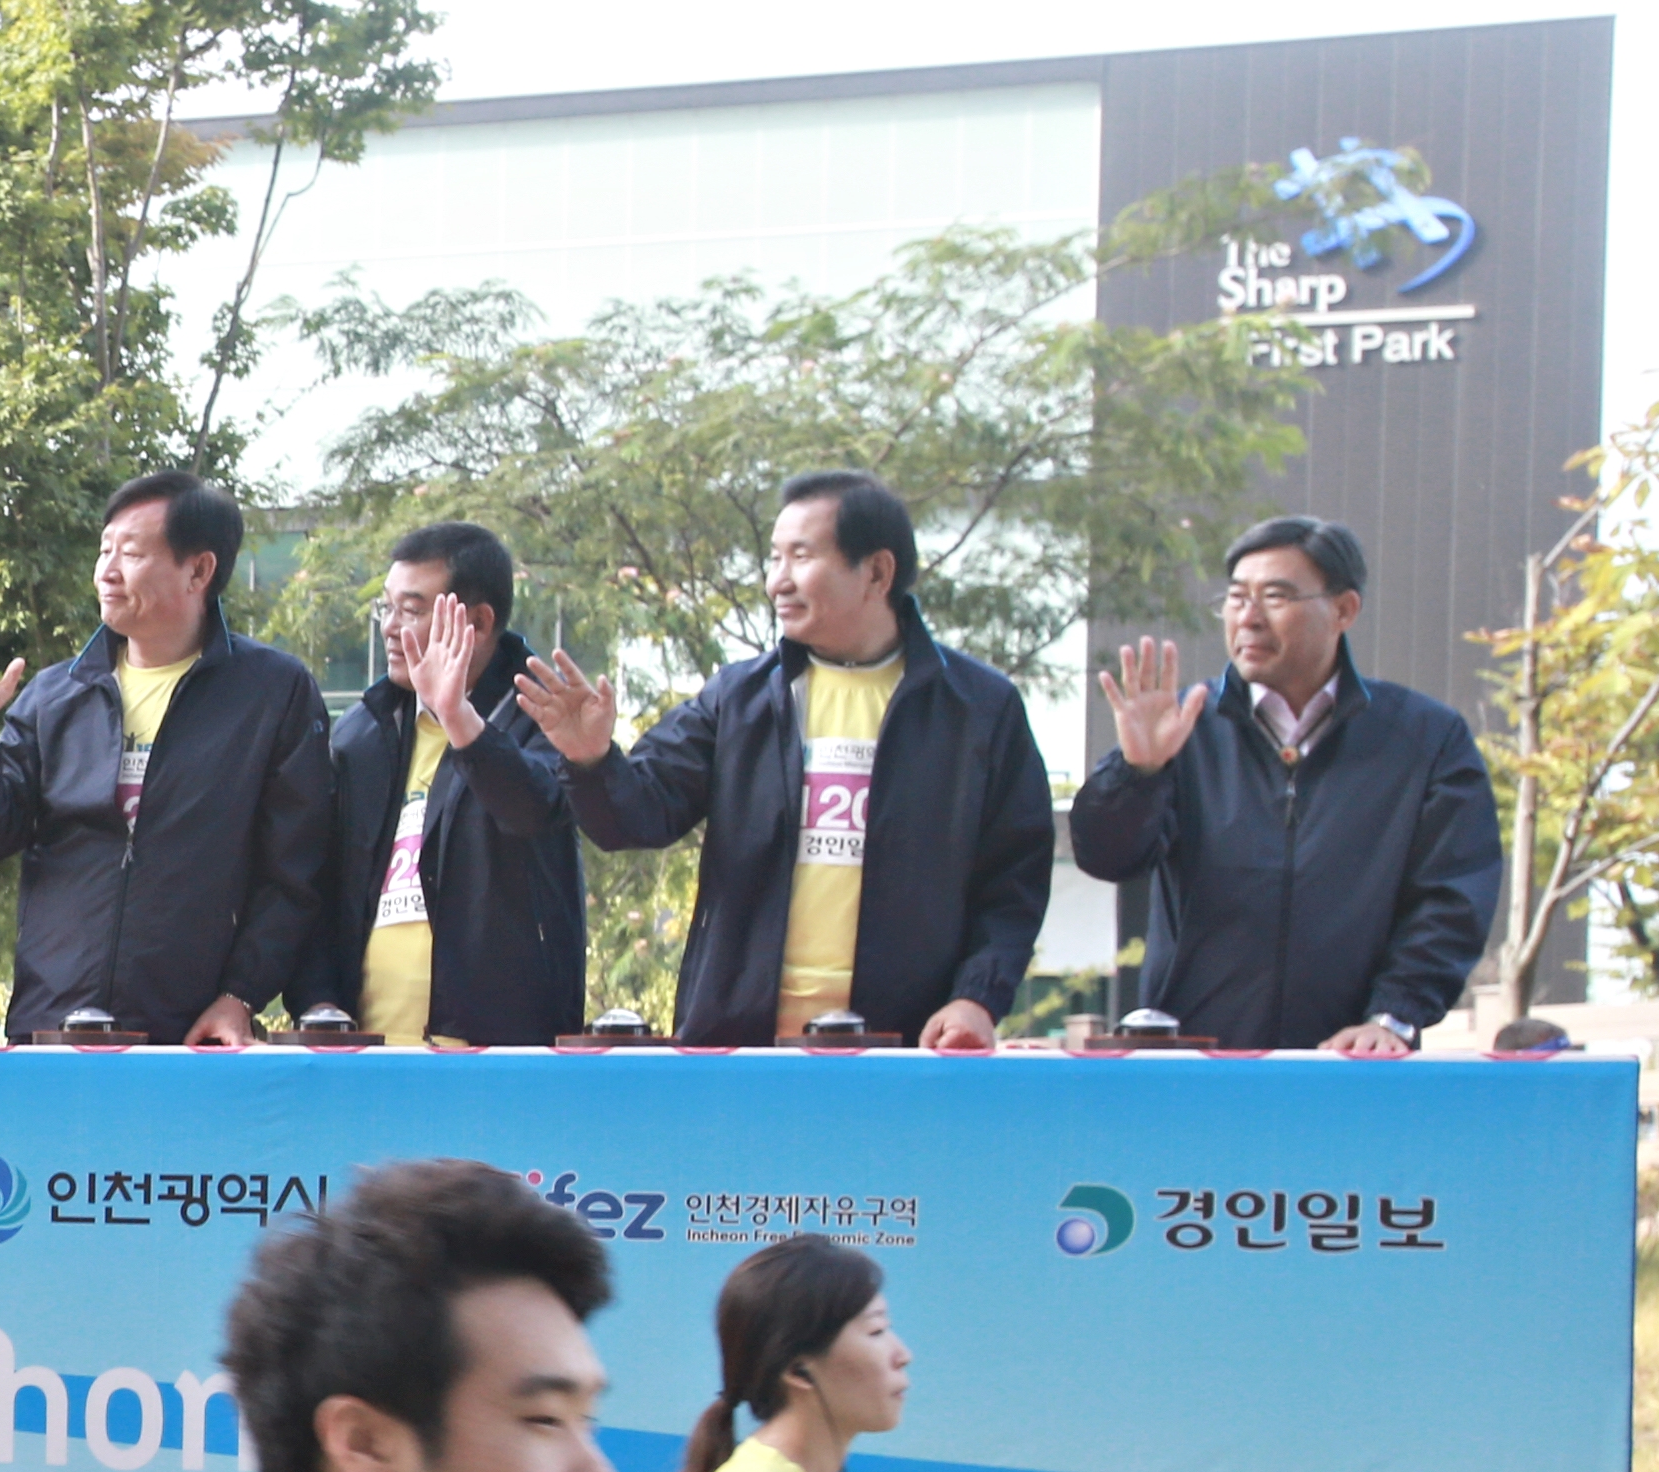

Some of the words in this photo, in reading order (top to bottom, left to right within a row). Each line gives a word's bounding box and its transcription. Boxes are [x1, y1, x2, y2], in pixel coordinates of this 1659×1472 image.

[1221, 233, 1292, 268] The
[1217, 266, 1347, 312] Sharp
[1351, 322, 1455, 364] Park
[47, 1171, 328, 1228] 인천광역시
[686, 1193, 918, 1227] 인천경제자유구역
[687, 1228, 748, 1243] Incheon
[754, 1230, 787, 1245] Free
[875, 1231, 915, 1247] Zone
[1156, 1190, 1445, 1252] 경인일보
